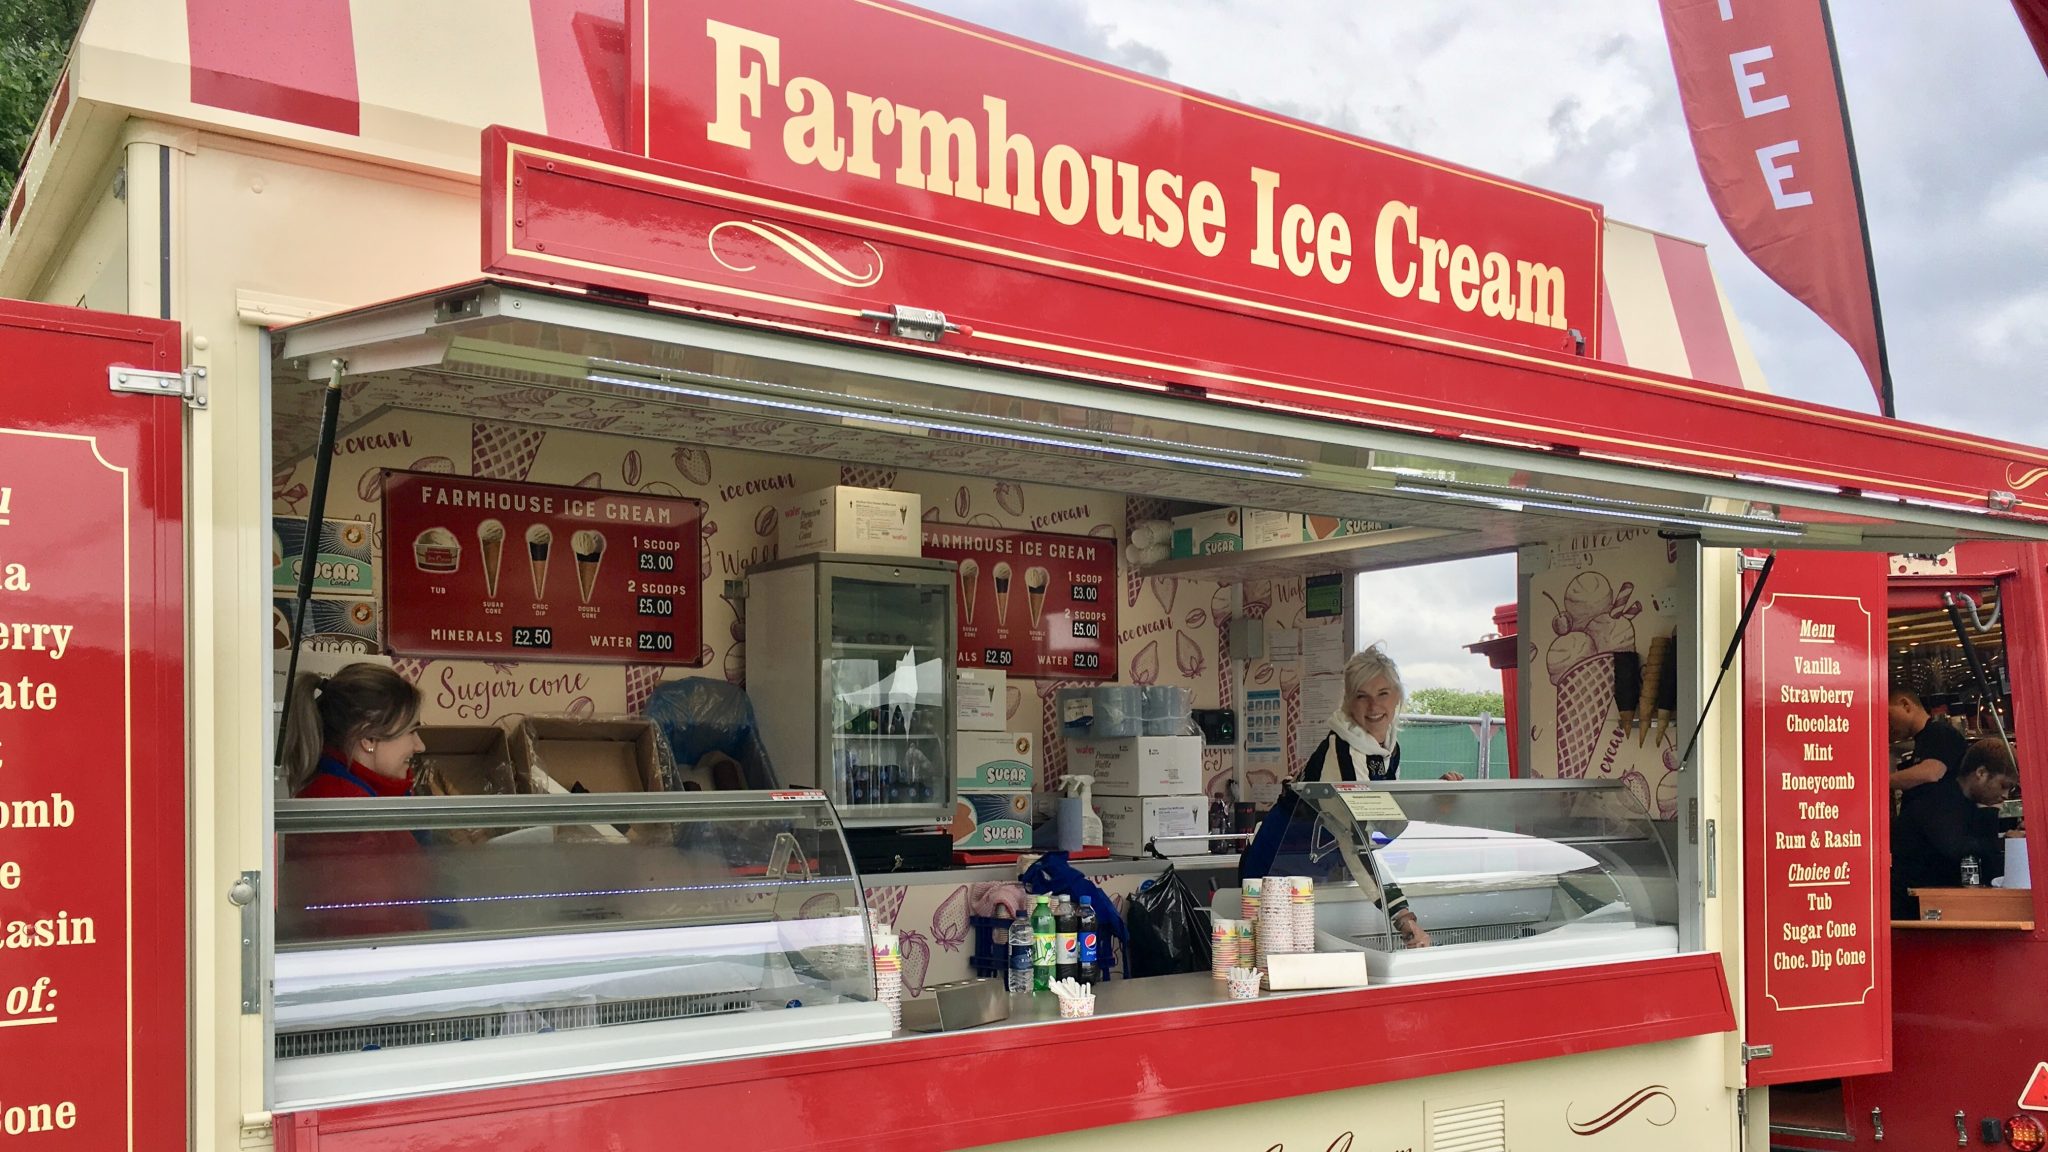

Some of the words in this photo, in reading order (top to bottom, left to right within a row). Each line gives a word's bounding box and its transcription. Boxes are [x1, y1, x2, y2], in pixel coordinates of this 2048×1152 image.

[706, 18, 1227, 258] Farmhouse
[1250, 167, 1352, 285] Ice
[1374, 201, 1569, 331] Cream
[345, 430, 413, 454] cream
[719, 484, 745, 502] ice
[745, 473, 796, 496] cream
[421, 486, 553, 514] FARMHOUSE
[564, 500, 596, 518] ICE
[605, 503, 672, 524] CREAM
[1051, 504, 1091, 523] cream
[632, 536, 638, 549] 1
[643, 539, 680, 551] SCOOP
[921, 533, 1013, 554] FARMHOUSE
[1020, 541, 1042, 557] ICE
[1049, 544, 1096, 561] CREAM
[1205, 540, 1235, 556] SUGAR
[640, 554, 673, 570] £3.00
[1067, 571, 1073, 582] 1
[1075, 574, 1103, 584] SCOOP
[431, 586, 447, 595] TUB
[628, 580, 636, 592] 2
[642, 583, 686, 596] SCOOPS
[1073, 586, 1097, 600] £3.00
[640, 598, 672, 615] £5.00
[1065, 608, 1070, 619] 2
[1074, 611, 1106, 621] SCOOPS
[1073, 622, 1097, 636] £5.00
[1136, 616, 1174, 637] cream
[1800, 619, 1836, 638] Menu
[431, 629, 503, 643] MINERALS
[515, 629, 551, 646] £2.50
[590, 635, 633, 648] WATER
[639, 634, 672, 650] £2.00
[985, 649, 1011, 665] £2.50
[1037, 655, 1068, 666] WATER
[1074, 654, 1098, 668] £2.00
[1794, 656, 1841, 675] Vanilla
[437, 666, 523, 719] Sugar
[528, 670, 590, 698] cone
[1780, 685, 1854, 707] Strawberry
[1786, 714, 1850, 733] Chocolate
[1803, 743, 1833, 761] Mint
[987, 767, 1026, 784] SUGAR
[1781, 772, 1855, 794] Honeycomb
[1798, 802, 1839, 820] Toffee
[983, 826, 1023, 843] SUGAR
[1775, 831, 1806, 849] Rum
[1810, 830, 1820, 848] &
[1824, 830, 1862, 848] Rasin
[1788, 863, 1831, 882] Choice
[1834, 861, 1850, 881] of:
[1807, 893, 1833, 911] Tub
[0, 911, 96, 949] asin
[1783, 922, 1823, 944] Sugar
[1826, 920, 1857, 938] Cone
[1773, 952, 1809, 971] Choc.
[1811, 950, 1832, 971] Dip
[1836, 948, 1866, 966] Cone
[6, 977, 58, 1015] of:
[0, 1101, 77, 1136] one
